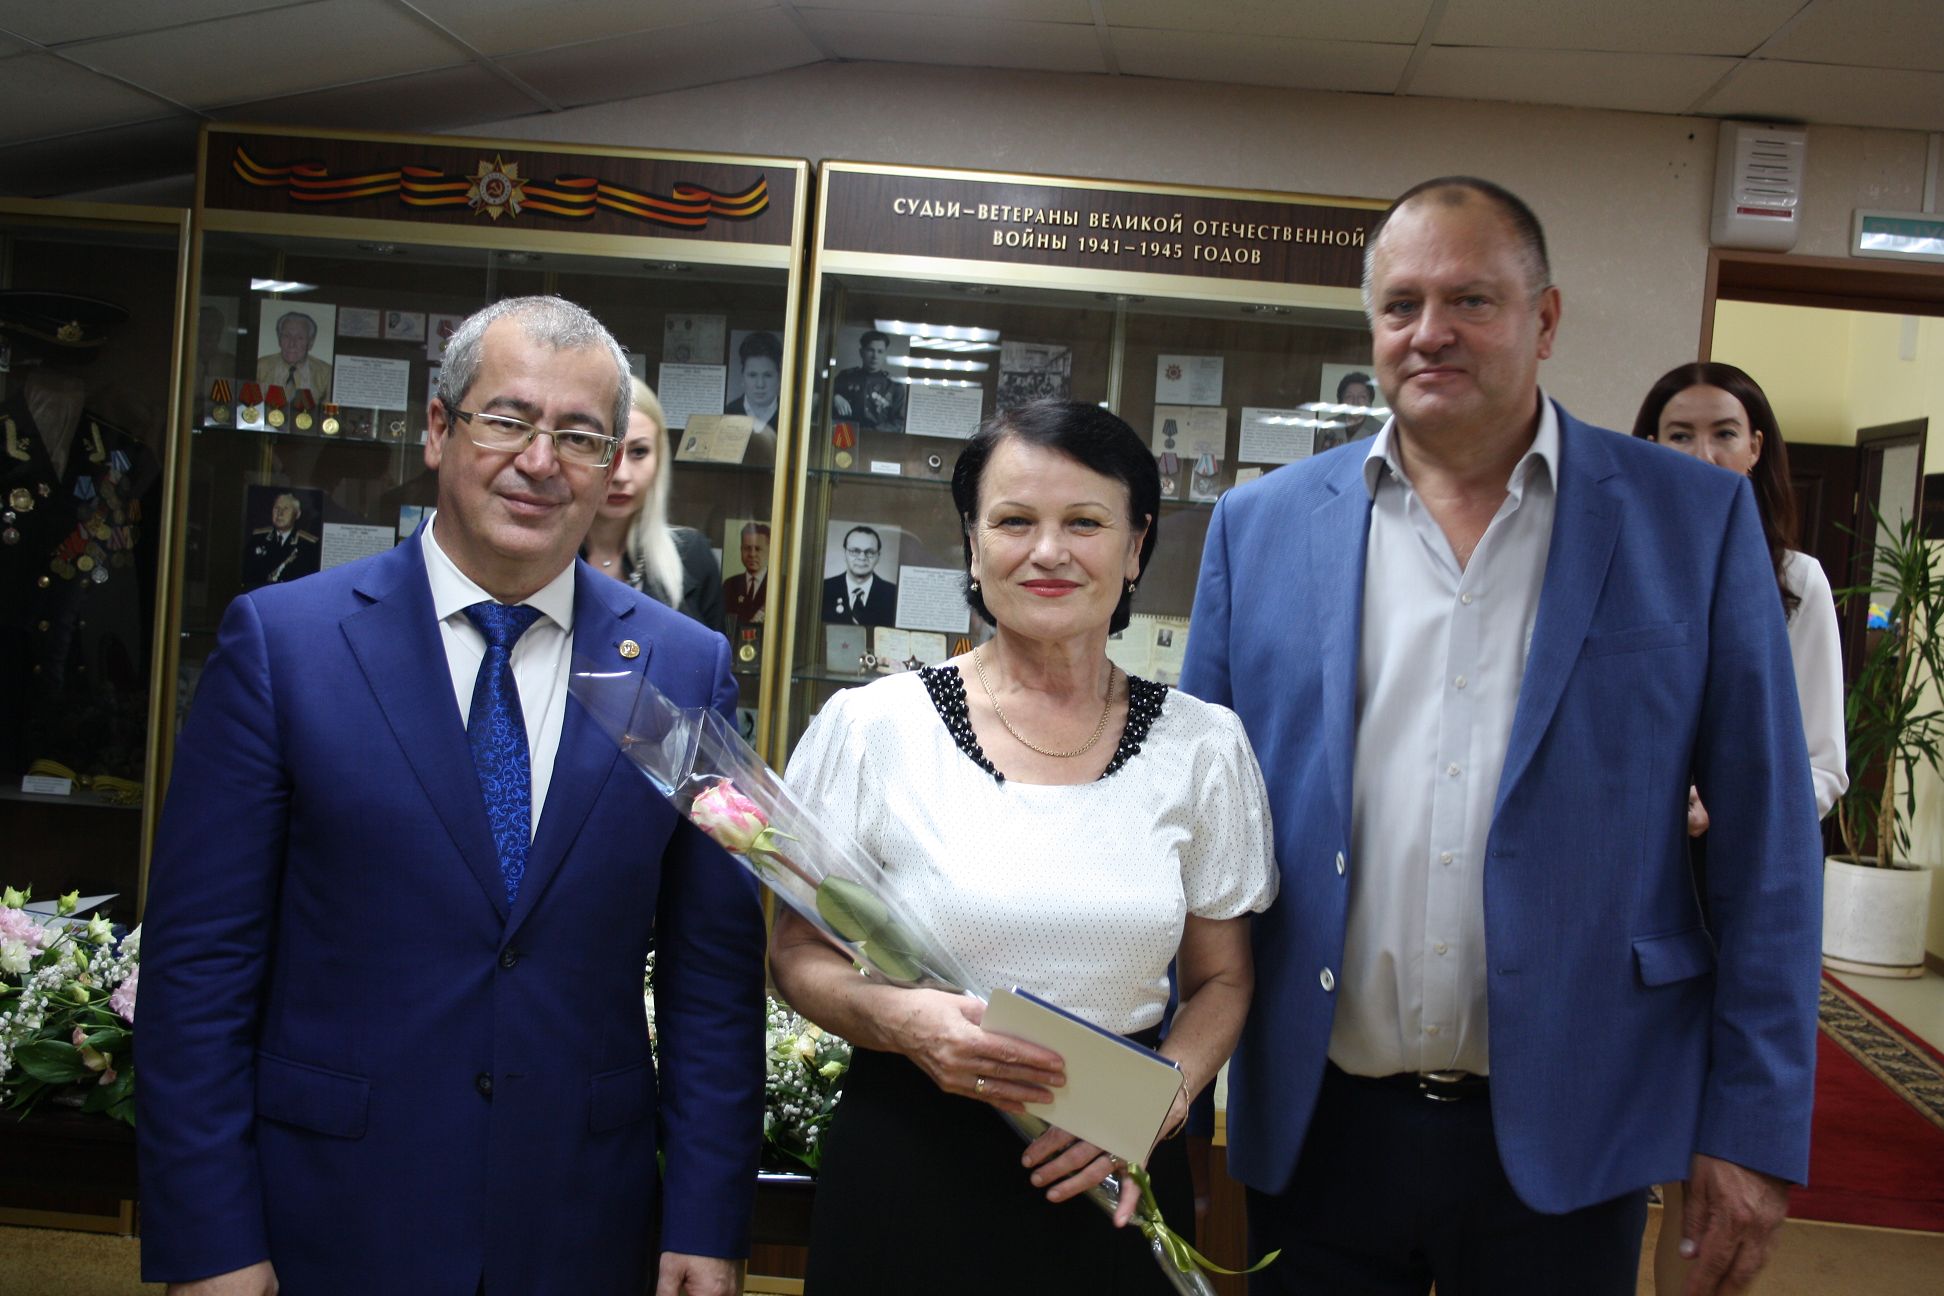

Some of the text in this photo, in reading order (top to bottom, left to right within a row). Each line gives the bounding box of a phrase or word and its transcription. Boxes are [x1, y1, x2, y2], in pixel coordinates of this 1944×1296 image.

[992, 228, 1067, 251] ВОЙНЫ
[1194, 244, 1262, 265] ГОДОВ
[1089, 212, 1183, 235] ВЕЛИКОЙ
[1193, 219, 1366, 249] ОТЕЧЕСТВЕННОЙ
